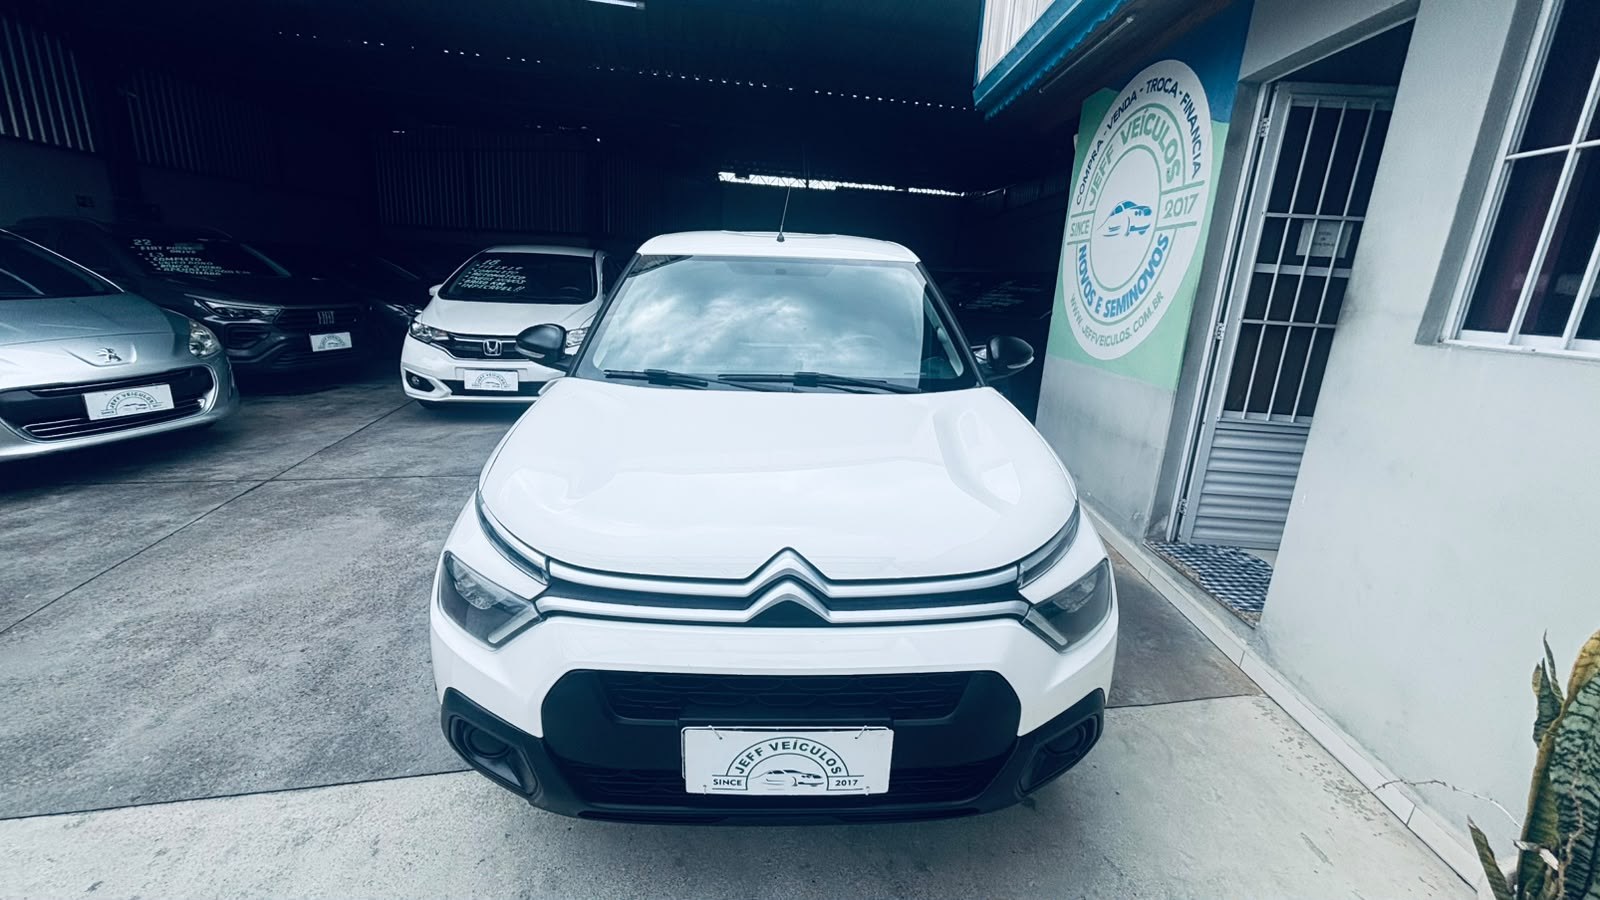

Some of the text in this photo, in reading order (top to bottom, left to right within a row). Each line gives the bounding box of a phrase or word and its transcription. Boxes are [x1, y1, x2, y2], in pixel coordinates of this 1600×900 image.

[1076, 139, 1104, 205] COMPRA
[1106, 90, 1137, 130] VENDA
[1145, 77, 1179, 98] TROCA
[1180, 92, 1202, 179] FINANCIA
[1089, 108, 1180, 206] JEFF VEÍCULOS
[1163, 193, 1199, 219] 2017
[1070, 219, 1090, 237] SINCE
[1078, 233, 1169, 318] NOVOS E SEMINOVOS
[734, 739, 842, 774] JEFF VEÍCULOS
[712, 778, 742, 787] SINCE
[835, 779, 858, 787] 2017
